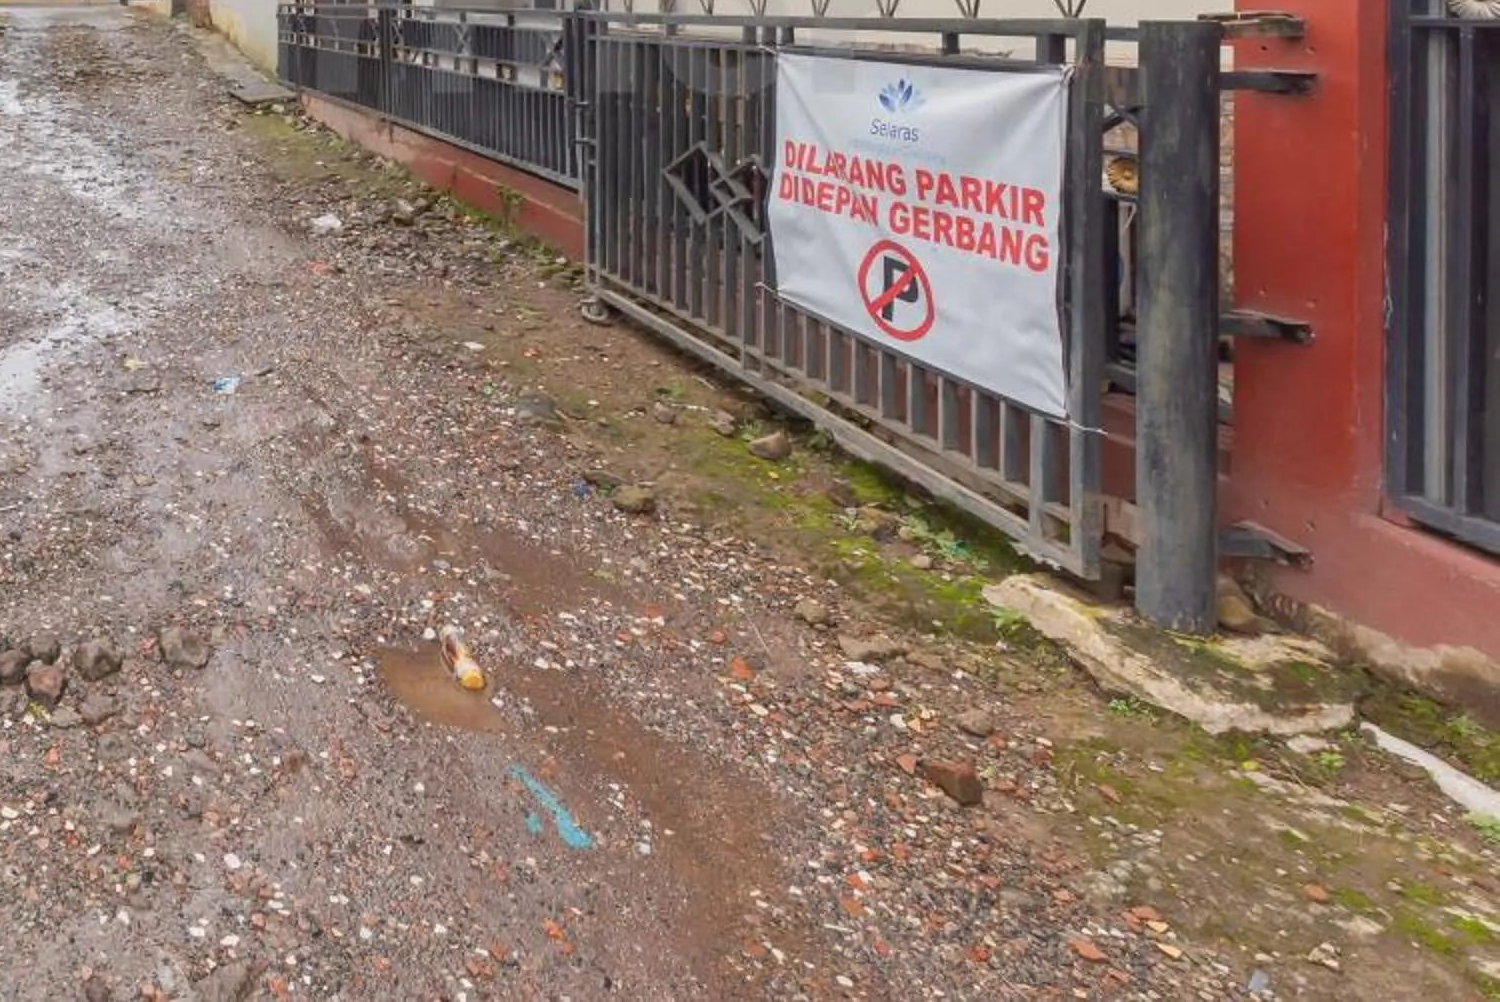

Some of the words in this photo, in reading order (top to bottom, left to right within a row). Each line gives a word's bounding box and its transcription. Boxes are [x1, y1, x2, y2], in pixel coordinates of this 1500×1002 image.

[870, 117, 920, 143] Selaras
[779, 172, 879, 227] DIDEPAN
[888, 201, 1049, 272] GERBANG
[784, 139, 907, 197] DILARANG
[915, 169, 1046, 227] PARKIR
